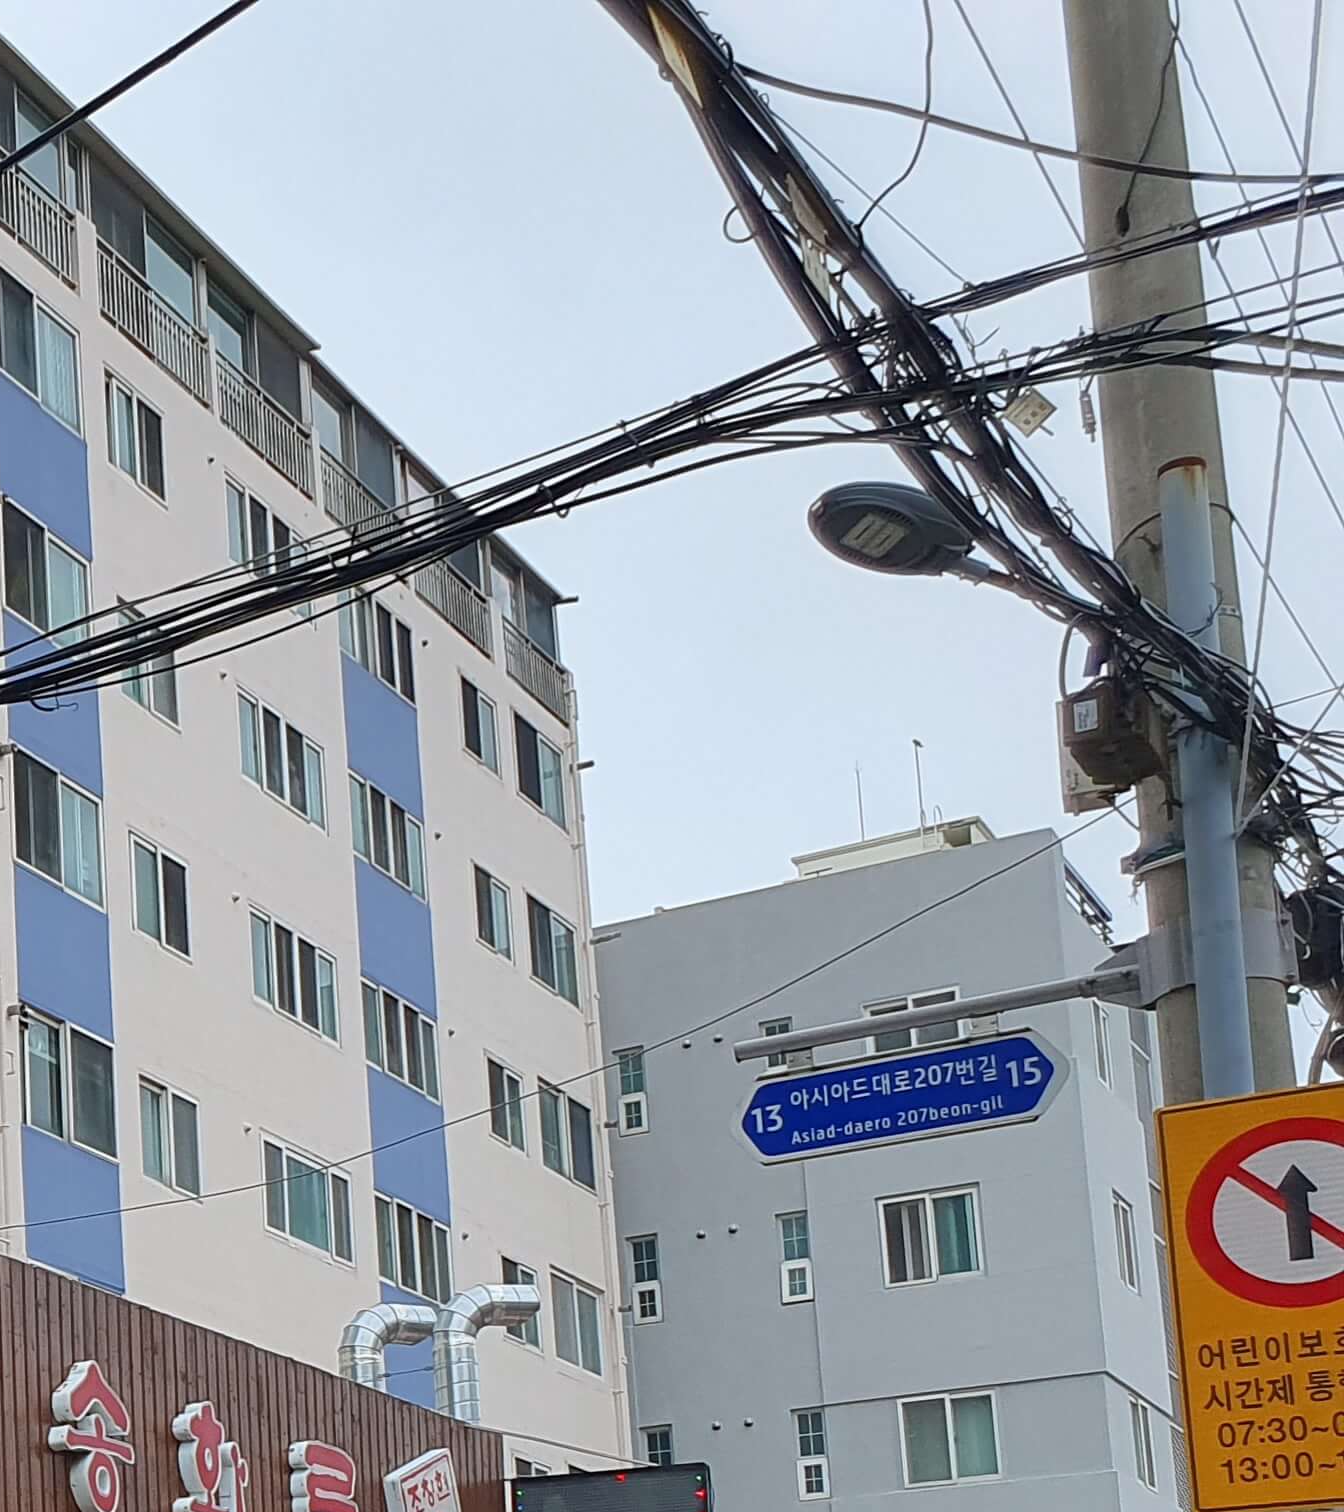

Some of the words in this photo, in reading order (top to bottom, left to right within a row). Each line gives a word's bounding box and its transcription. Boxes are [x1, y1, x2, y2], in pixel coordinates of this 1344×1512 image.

[789, 1053, 999, 1112] 아시아드대로207번길
[1005, 1055, 1044, 1090] 15
[750, 1103, 785, 1135] 13
[791, 1117, 892, 1146] Asiad-daero
[896, 1094, 1004, 1128] 207beon-gil
[1202, 1373, 1296, 1413] 시간제
